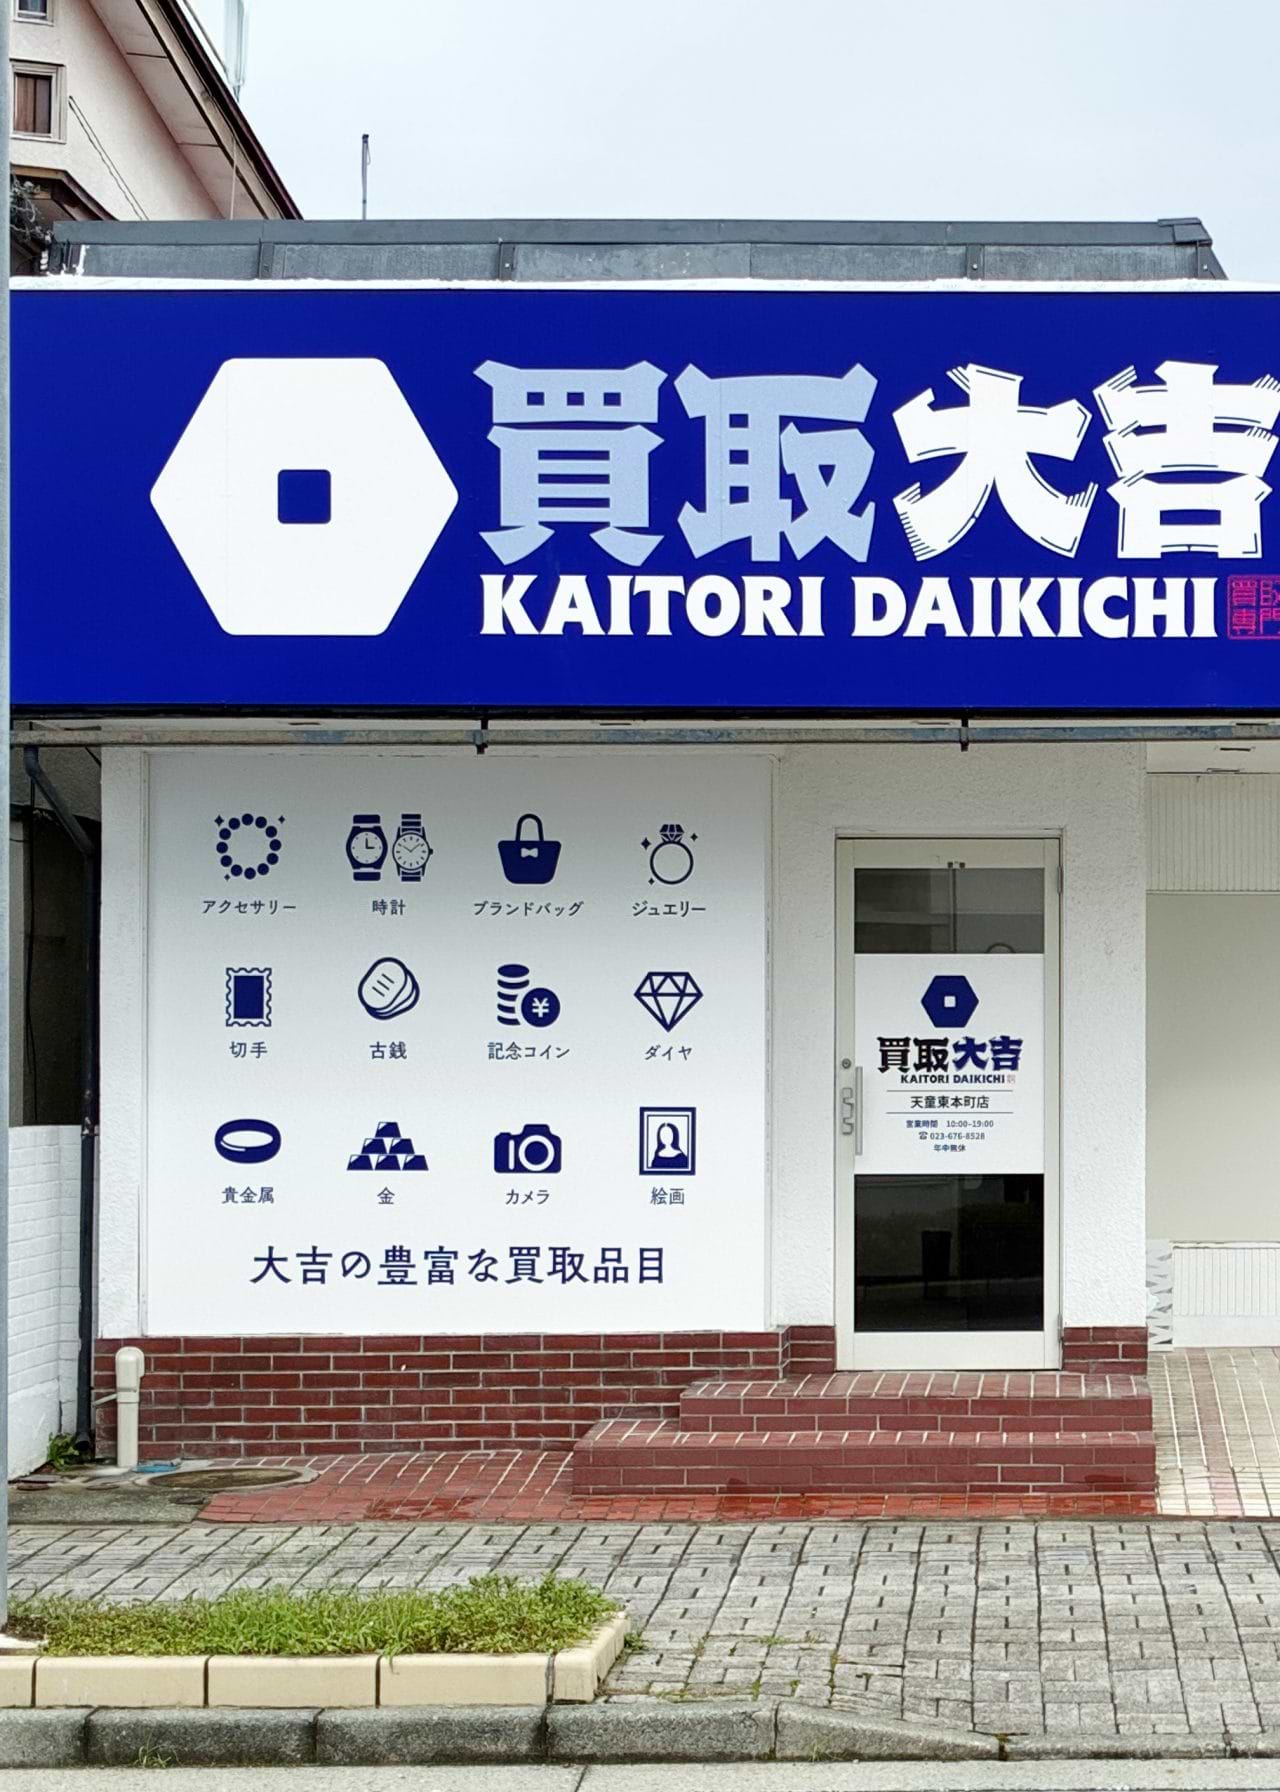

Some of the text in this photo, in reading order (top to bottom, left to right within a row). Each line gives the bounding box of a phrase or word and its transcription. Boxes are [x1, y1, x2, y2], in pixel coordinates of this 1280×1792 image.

[480, 575, 1217, 638] KAITORI DAIKICHI
[203, 900, 296, 915] アクセサリー
[372, 899, 406, 915] 時計
[474, 901, 584, 916] ブランドバッグ
[632, 900, 706, 917] ジュエリー
[229, 1041, 268, 1059] 切手
[369, 1041, 407, 1059] 古銭
[487, 1041, 570, 1060] 記念コイン
[645, 1045, 692, 1061] ダイヤ
[877, 1035, 1023, 1073] 買取大吉
[901, 1074, 949, 1083] KAITORI
[953, 1074, 1005, 1083] DAIKICHI
[911, 1095, 989, 1109] 天童東本町店
[222, 1186, 274, 1204] 貴金属
[377, 1187, 395, 1204] 金
[506, 1189, 549, 1204] カメラ
[650, 1187, 684, 1205] 絵画
[250, 1245, 665, 1285] 大吉の豊富な買取品目
